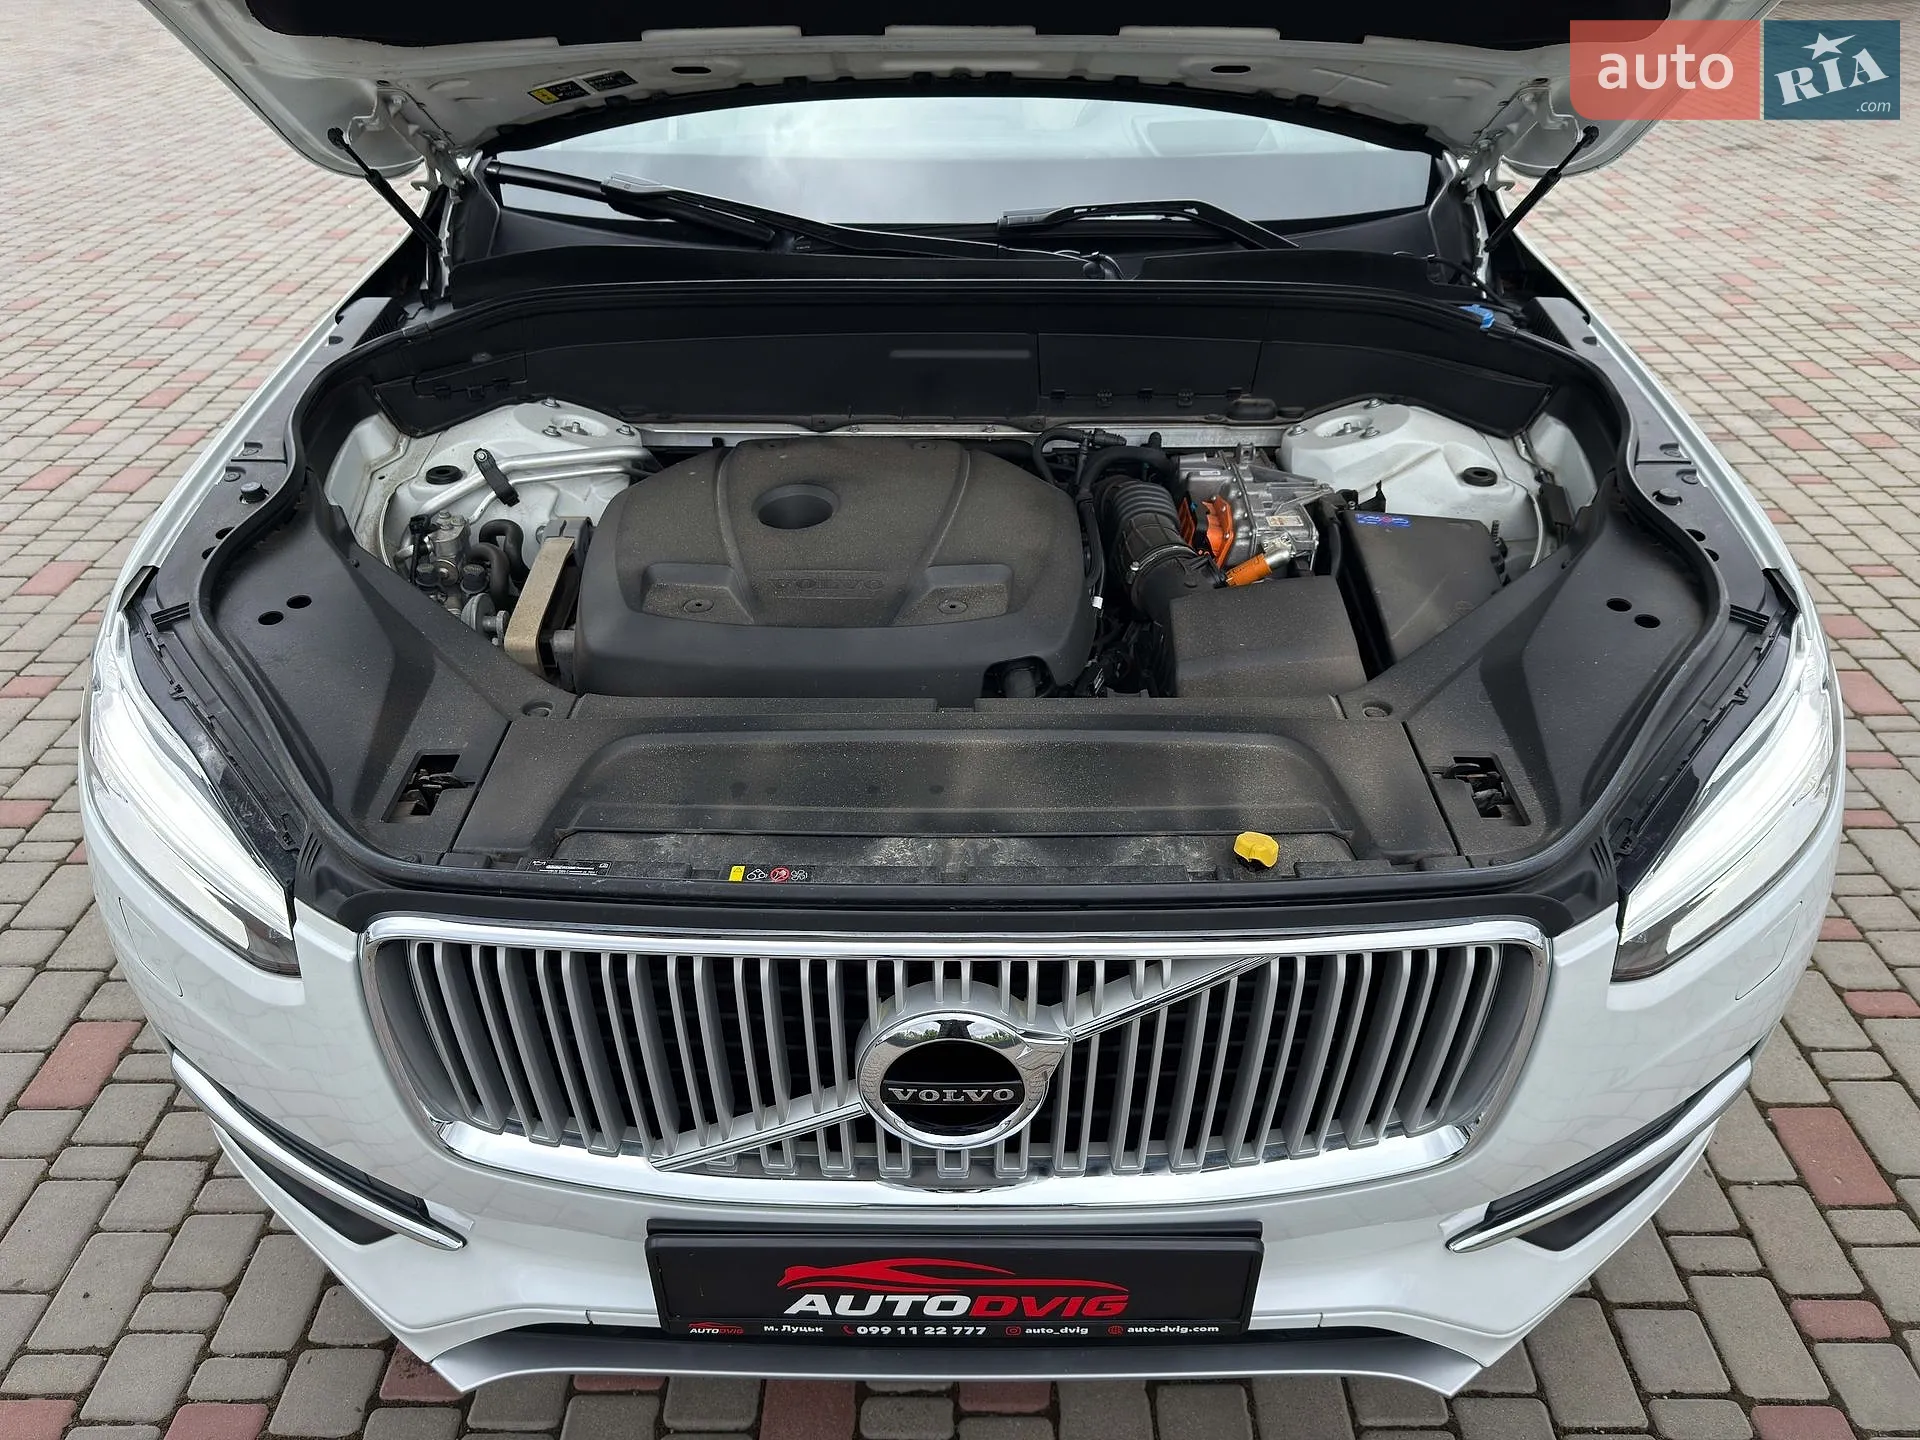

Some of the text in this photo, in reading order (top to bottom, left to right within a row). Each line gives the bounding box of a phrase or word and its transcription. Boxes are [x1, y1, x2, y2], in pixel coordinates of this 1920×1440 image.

[888, 1088, 1016, 1102] VOLVO
[783, 1293, 1129, 1317] AUTODVIG
[781, 1324, 824, 1333] Луцьк
[856, 1326, 987, 1335] 099 11 22 777
[1025, 1326, 1089, 1335] auto_dvig
[1127, 1324, 1220, 1335] auto-dvig.com
